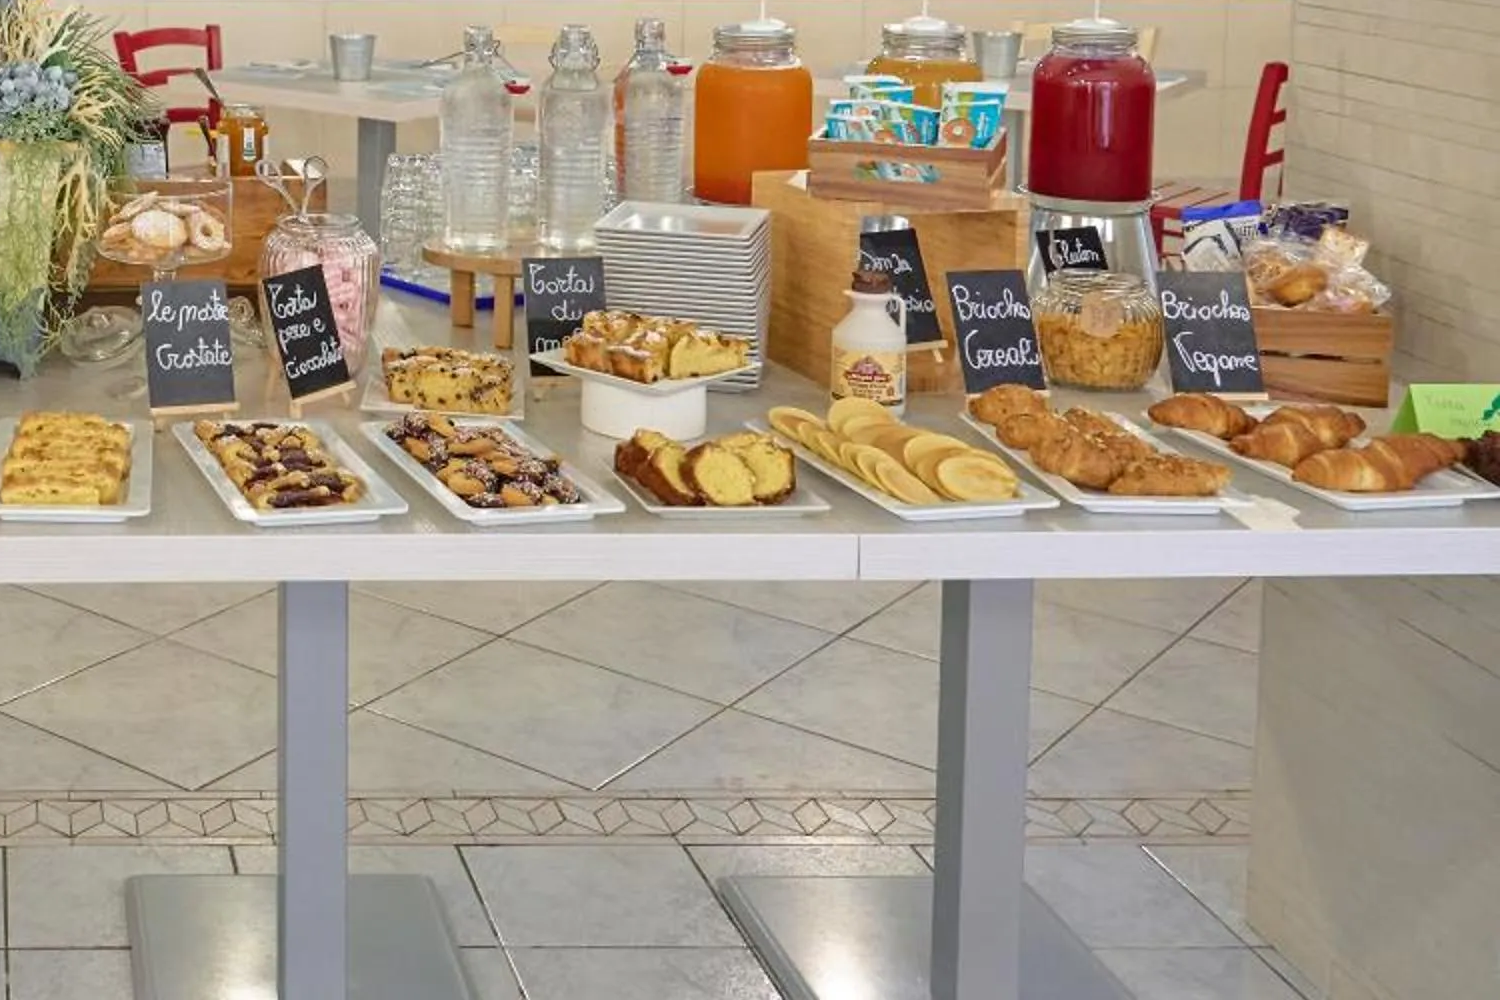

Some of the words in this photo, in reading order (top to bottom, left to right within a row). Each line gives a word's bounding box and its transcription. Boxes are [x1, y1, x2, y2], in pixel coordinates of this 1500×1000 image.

[528, 263, 595, 295] Torta
[952, 284, 1031, 322] Brioches
[1161, 289, 1251, 321] Brioches
